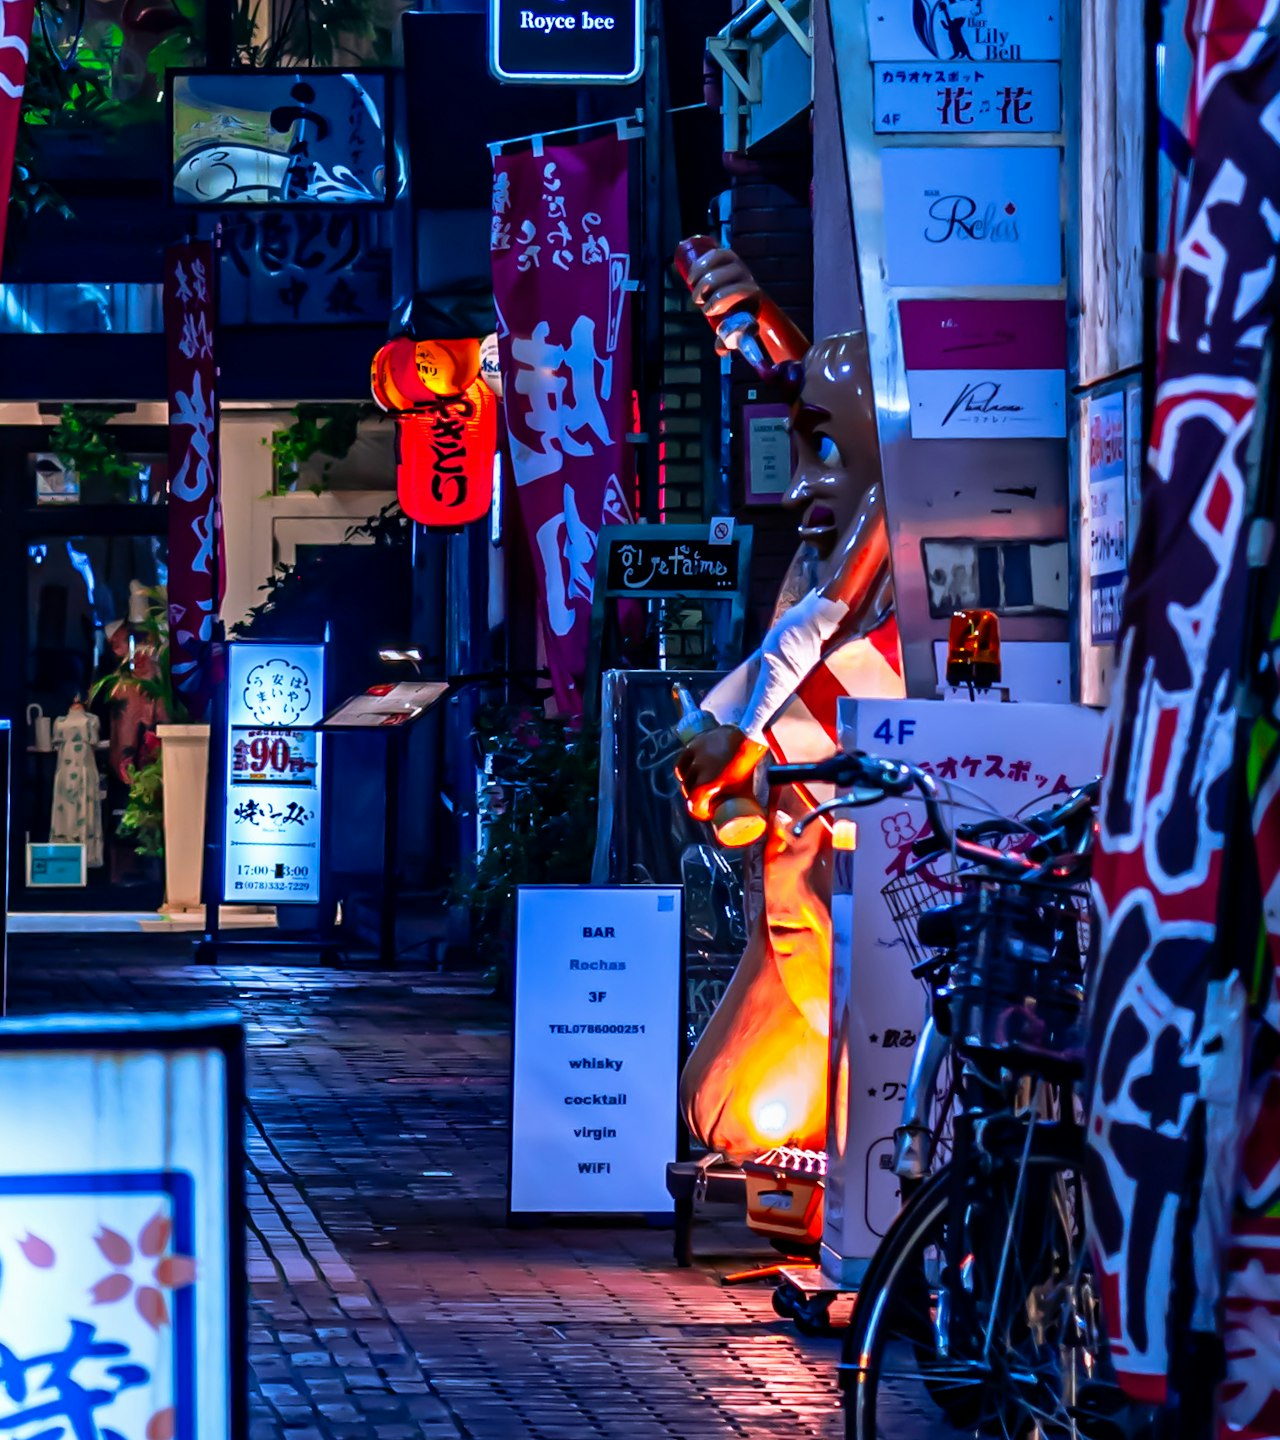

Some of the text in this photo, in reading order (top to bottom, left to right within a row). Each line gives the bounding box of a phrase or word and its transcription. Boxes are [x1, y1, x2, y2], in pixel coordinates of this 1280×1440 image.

[520, 11, 615, 32] Royce bee
[975, 27, 1009, 47] Lily
[985, 44, 1021, 61] Bell
[882, 71, 984, 83] カラオケスポット
[881, 113, 901, 126] 4F
[872, 718, 917, 745] 4F
[582, 926, 616, 938] BAR
[569, 958, 626, 971] Rochas
[588, 991, 607, 1003] 3F
[568, 1058, 623, 1072] whisky
[564, 1093, 627, 1106] cocktail
[573, 1126, 617, 1141] virgin
[577, 1162, 611, 1175] WiFi
